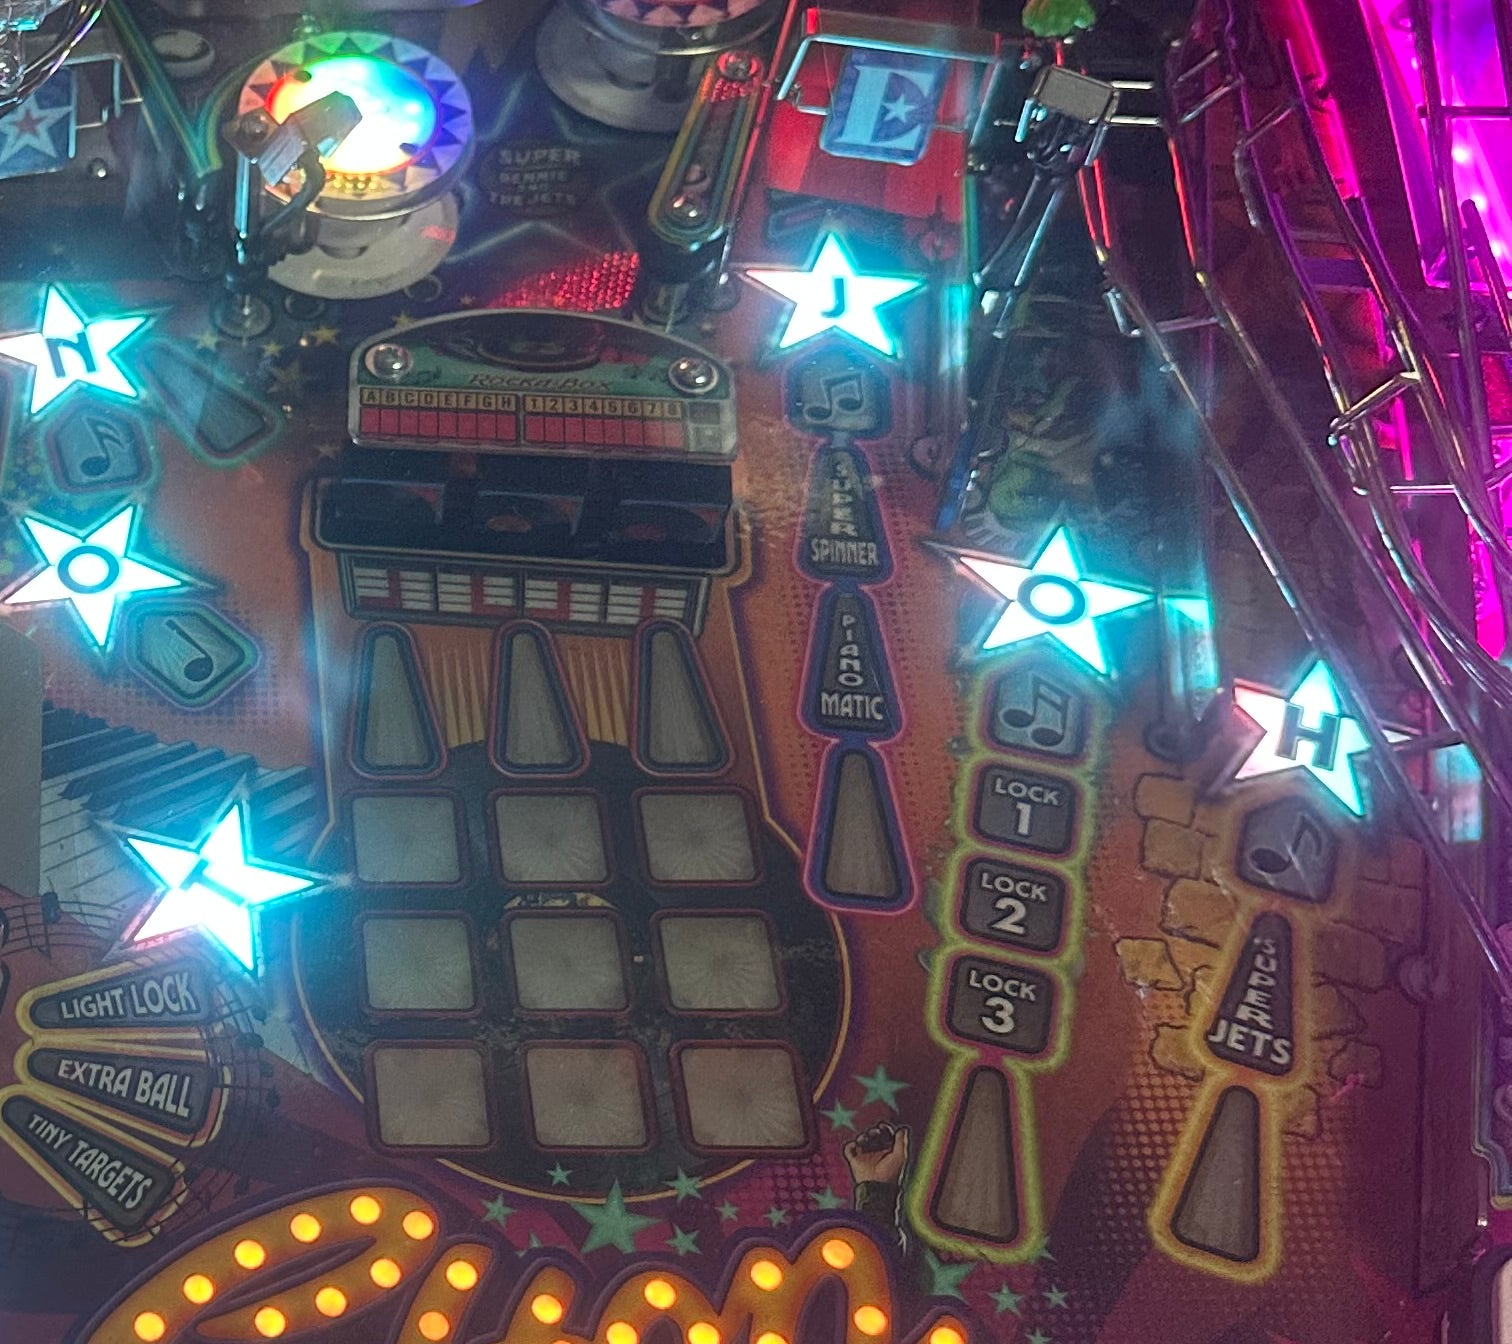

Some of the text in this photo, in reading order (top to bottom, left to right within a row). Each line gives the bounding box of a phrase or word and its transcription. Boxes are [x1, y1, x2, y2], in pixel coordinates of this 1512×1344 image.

[834, 64, 935, 151] E
[821, 277, 846, 318] J
[45, 330, 97, 378] N
[829, 460, 859, 538] SUPER
[57, 545, 120, 595] O
[810, 539, 880, 566] SPINNER
[1017, 572, 1087, 623] O
[838, 613, 865, 688] PIANO
[820, 690, 885, 722] MATIC
[1273, 702, 1346, 768] H
[995, 777, 1059, 806] LOCK
[1016, 802, 1032, 835] 1
[177, 859, 248, 907] T
[981, 872, 1048, 903] LOCK
[991, 896, 1027, 935] 2
[61, 971, 197, 1019] LIGHT LOCK
[969, 969, 1037, 1001] LOCK
[1235, 936, 1278, 1030] SUPER
[981, 996, 1015, 1035] 3
[1207, 1019, 1292, 1065] JETS
[57, 1058, 190, 1118] EXTRA BALL
[28, 1113, 153, 1210] TINY TARGETS
